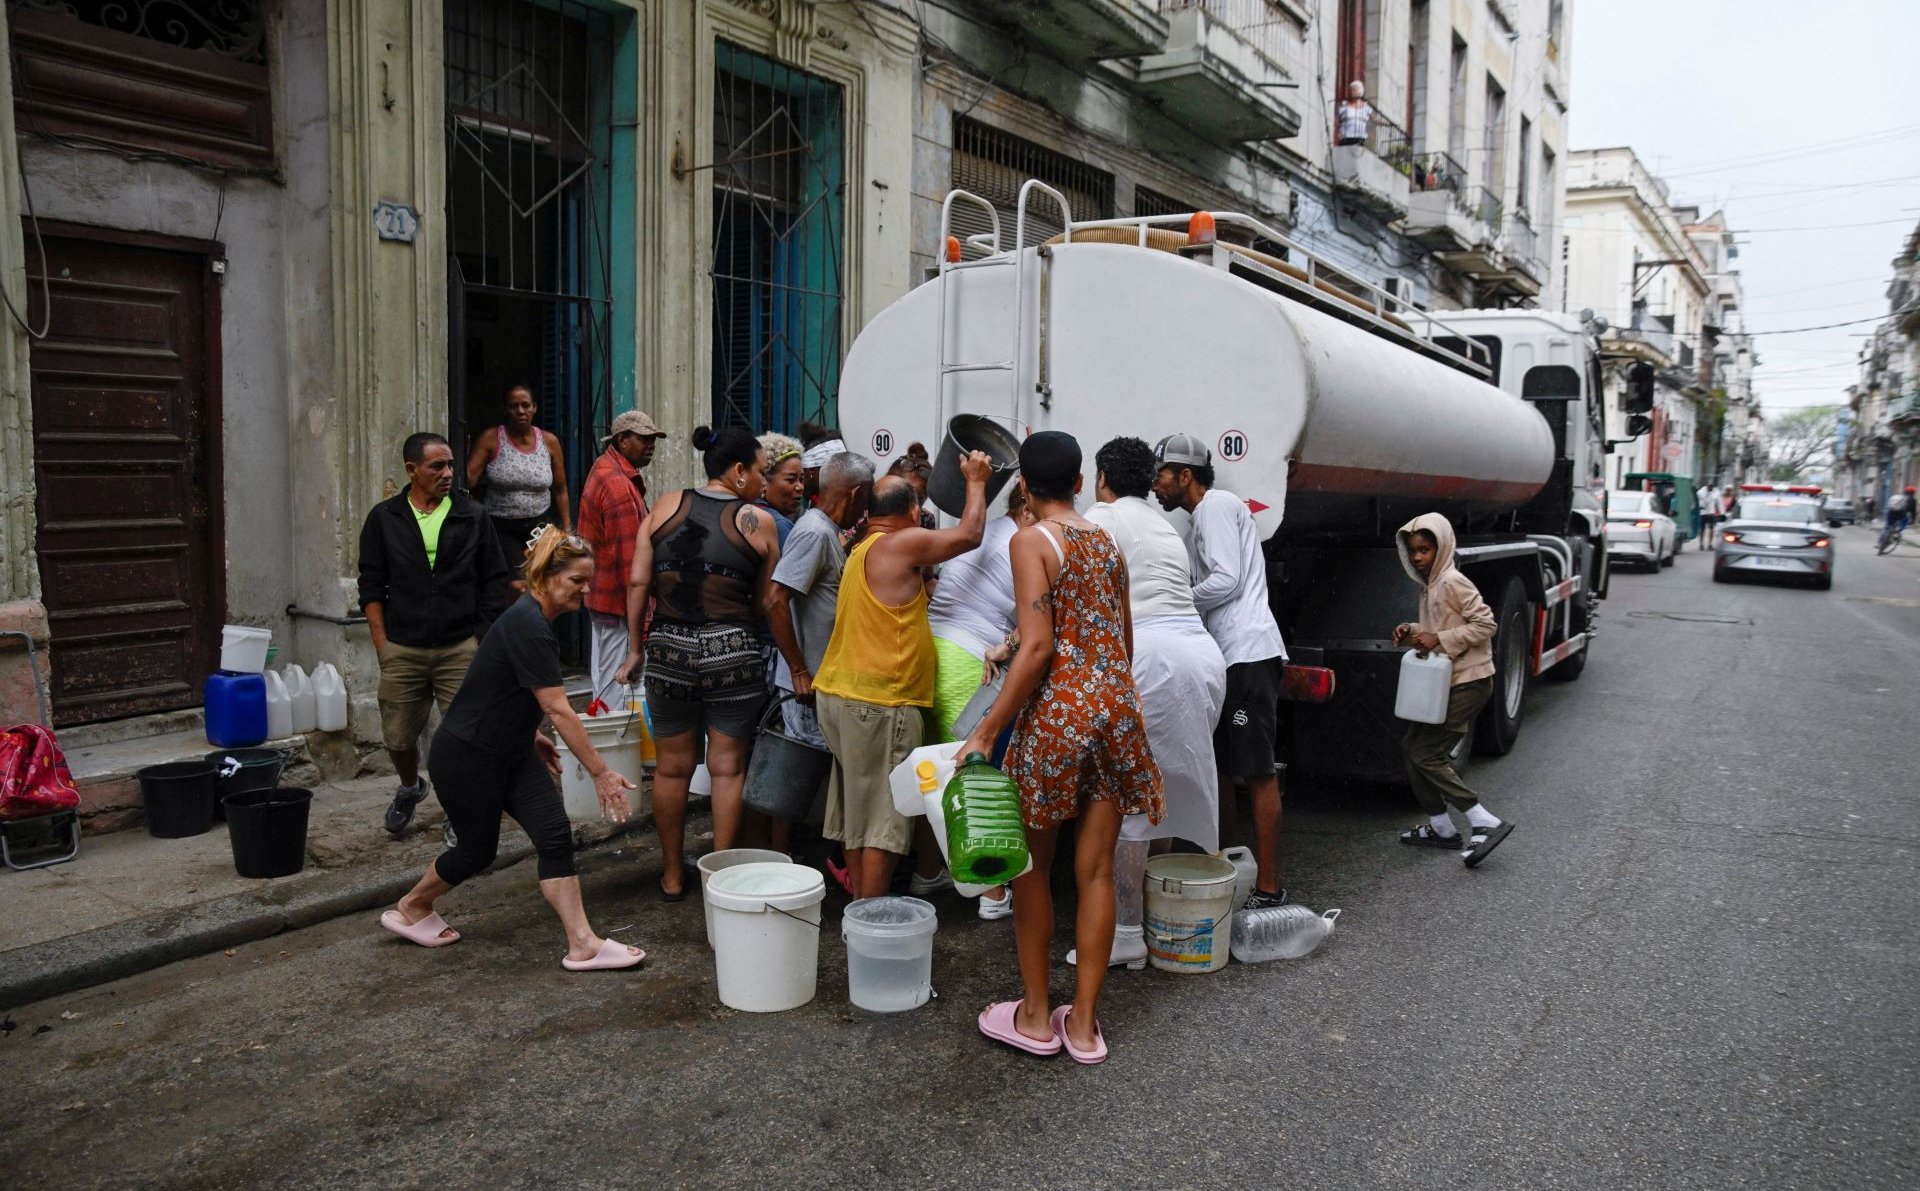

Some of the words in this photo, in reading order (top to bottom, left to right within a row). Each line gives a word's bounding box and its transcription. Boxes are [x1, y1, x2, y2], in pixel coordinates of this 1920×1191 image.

[385, 209, 406, 234] 71
[876, 434, 890, 451] 90
[1223, 436, 1243, 456] 80
